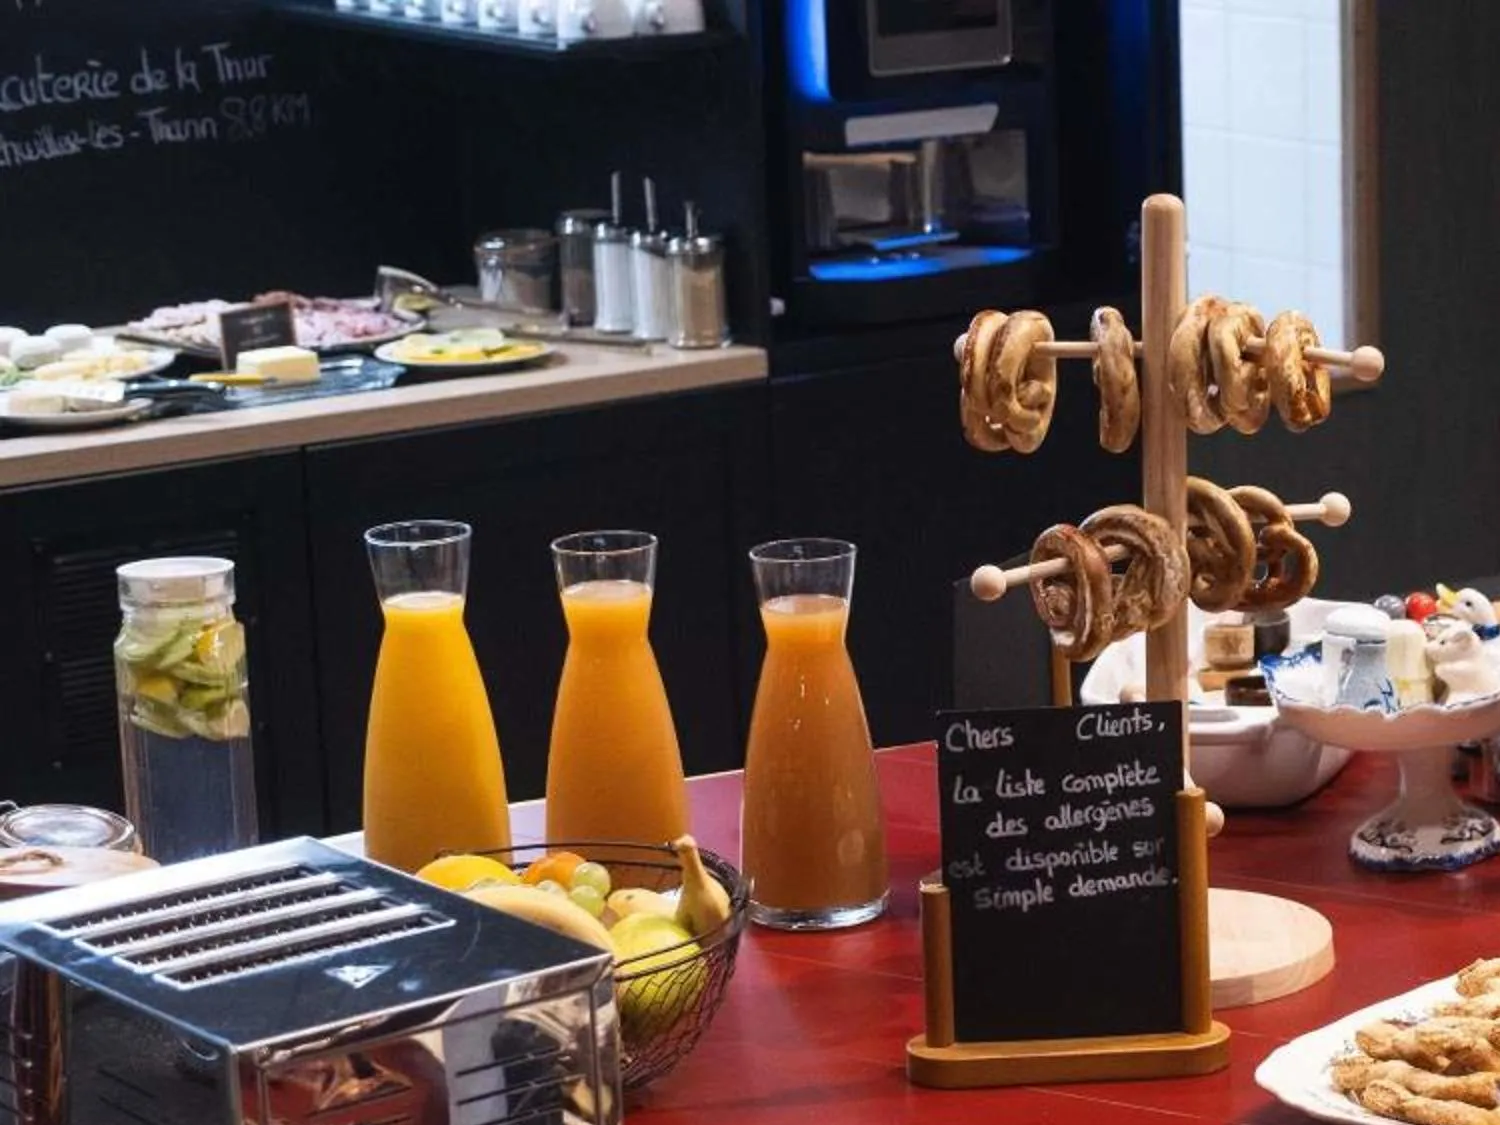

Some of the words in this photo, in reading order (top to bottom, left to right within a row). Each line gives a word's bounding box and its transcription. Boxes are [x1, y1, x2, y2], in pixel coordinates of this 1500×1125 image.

[130, 48, 170, 94] de
[945, 719, 1014, 752] Chers
[985, 811, 1029, 839] des
[948, 852, 986, 879] est
[1005, 840, 1119, 878] disponible
